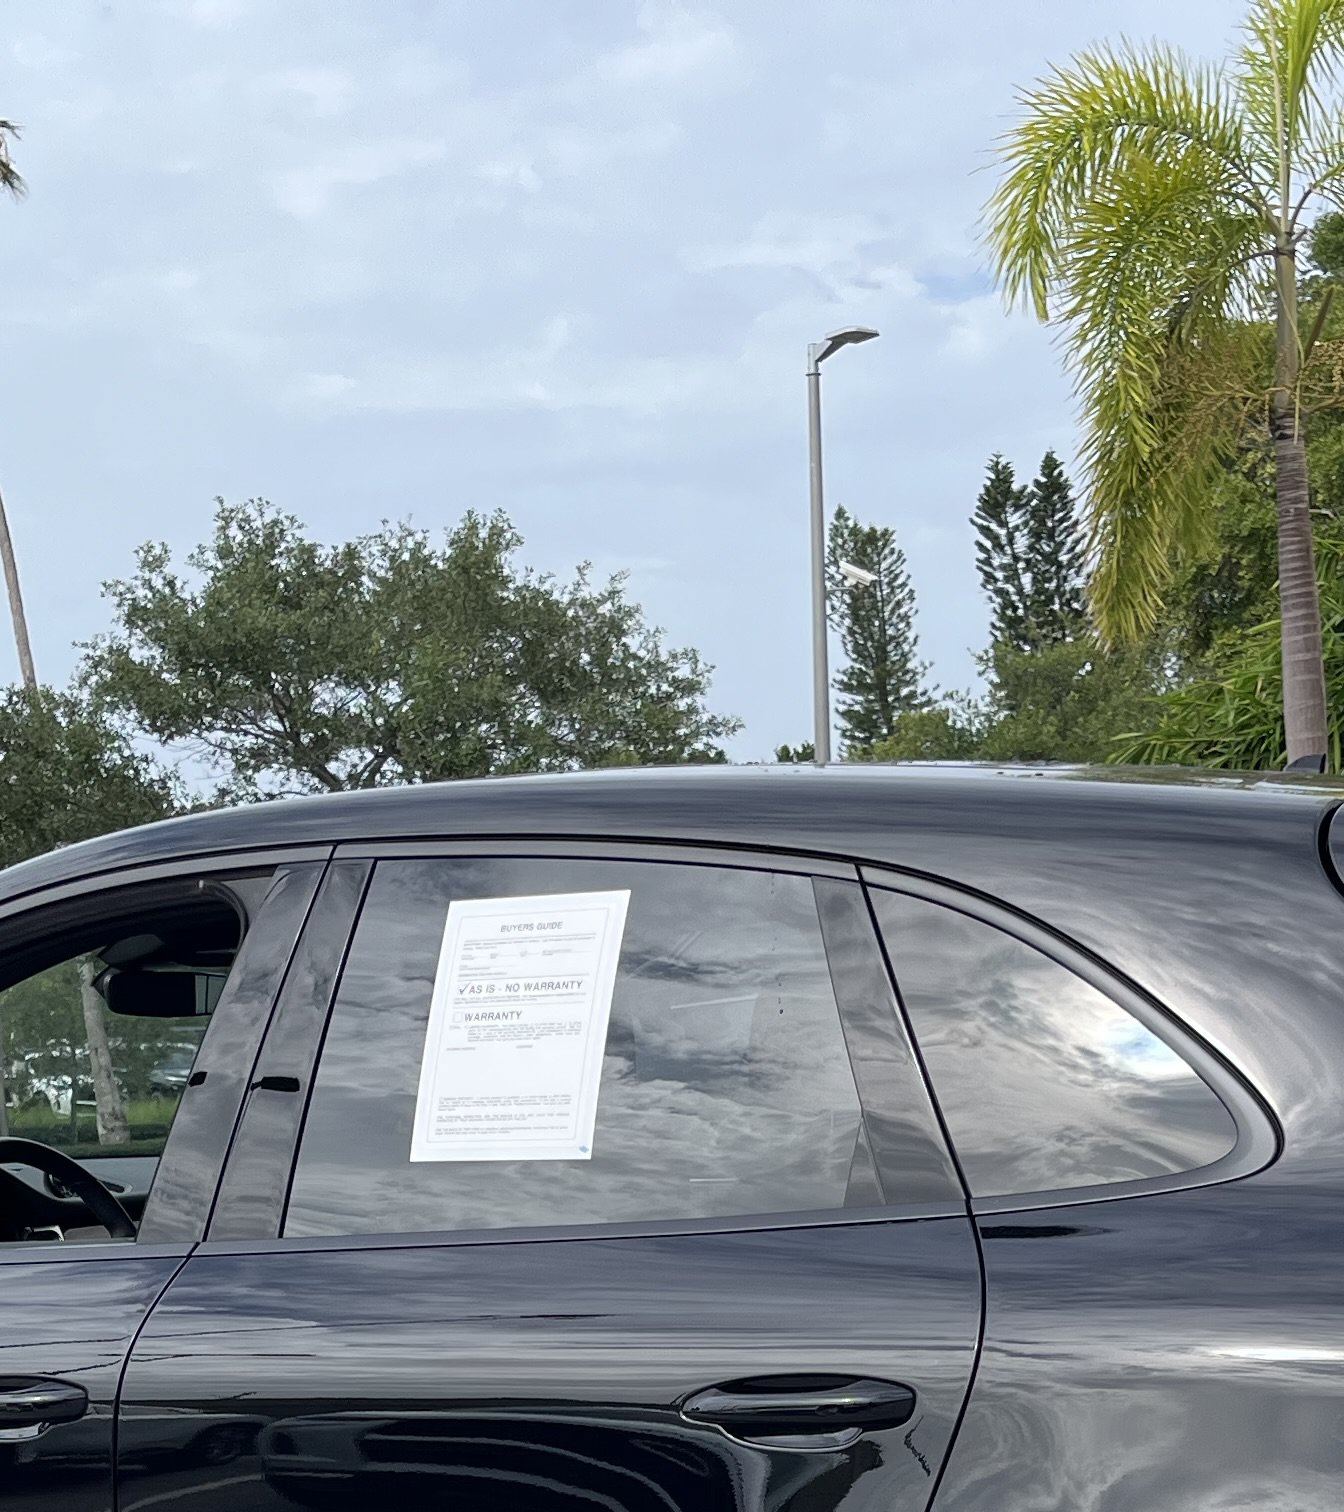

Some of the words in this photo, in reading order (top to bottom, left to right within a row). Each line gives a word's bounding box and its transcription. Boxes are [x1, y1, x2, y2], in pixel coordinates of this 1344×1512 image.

[469, 984, 483, 995] AS
[486, 984, 496, 994] IS
[505, 982, 521, 993] NO
[524, 980, 583, 992] WARRANTY
[465, 1011, 522, 1023] WARRANTY
